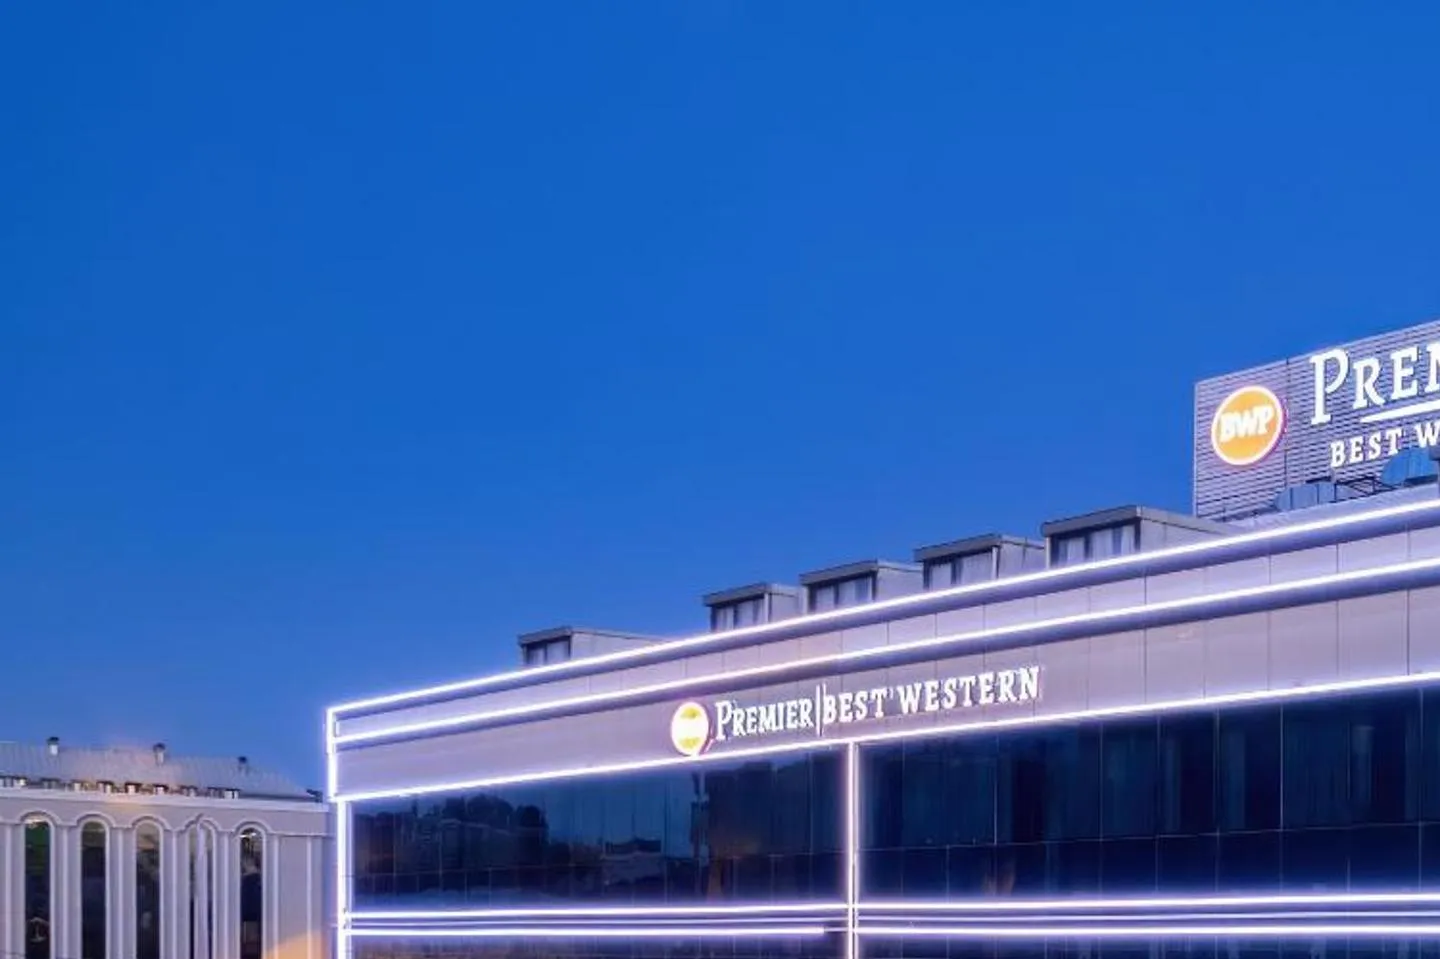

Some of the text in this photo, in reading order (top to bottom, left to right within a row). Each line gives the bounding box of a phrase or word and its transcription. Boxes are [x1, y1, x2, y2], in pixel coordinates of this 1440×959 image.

[1219, 404, 1274, 443] BWP
[1329, 428, 1404, 469] BEST
[715, 697, 814, 742] PREMIER
[823, 687, 888, 725] BEST
[896, 665, 1043, 716] WESTERN
